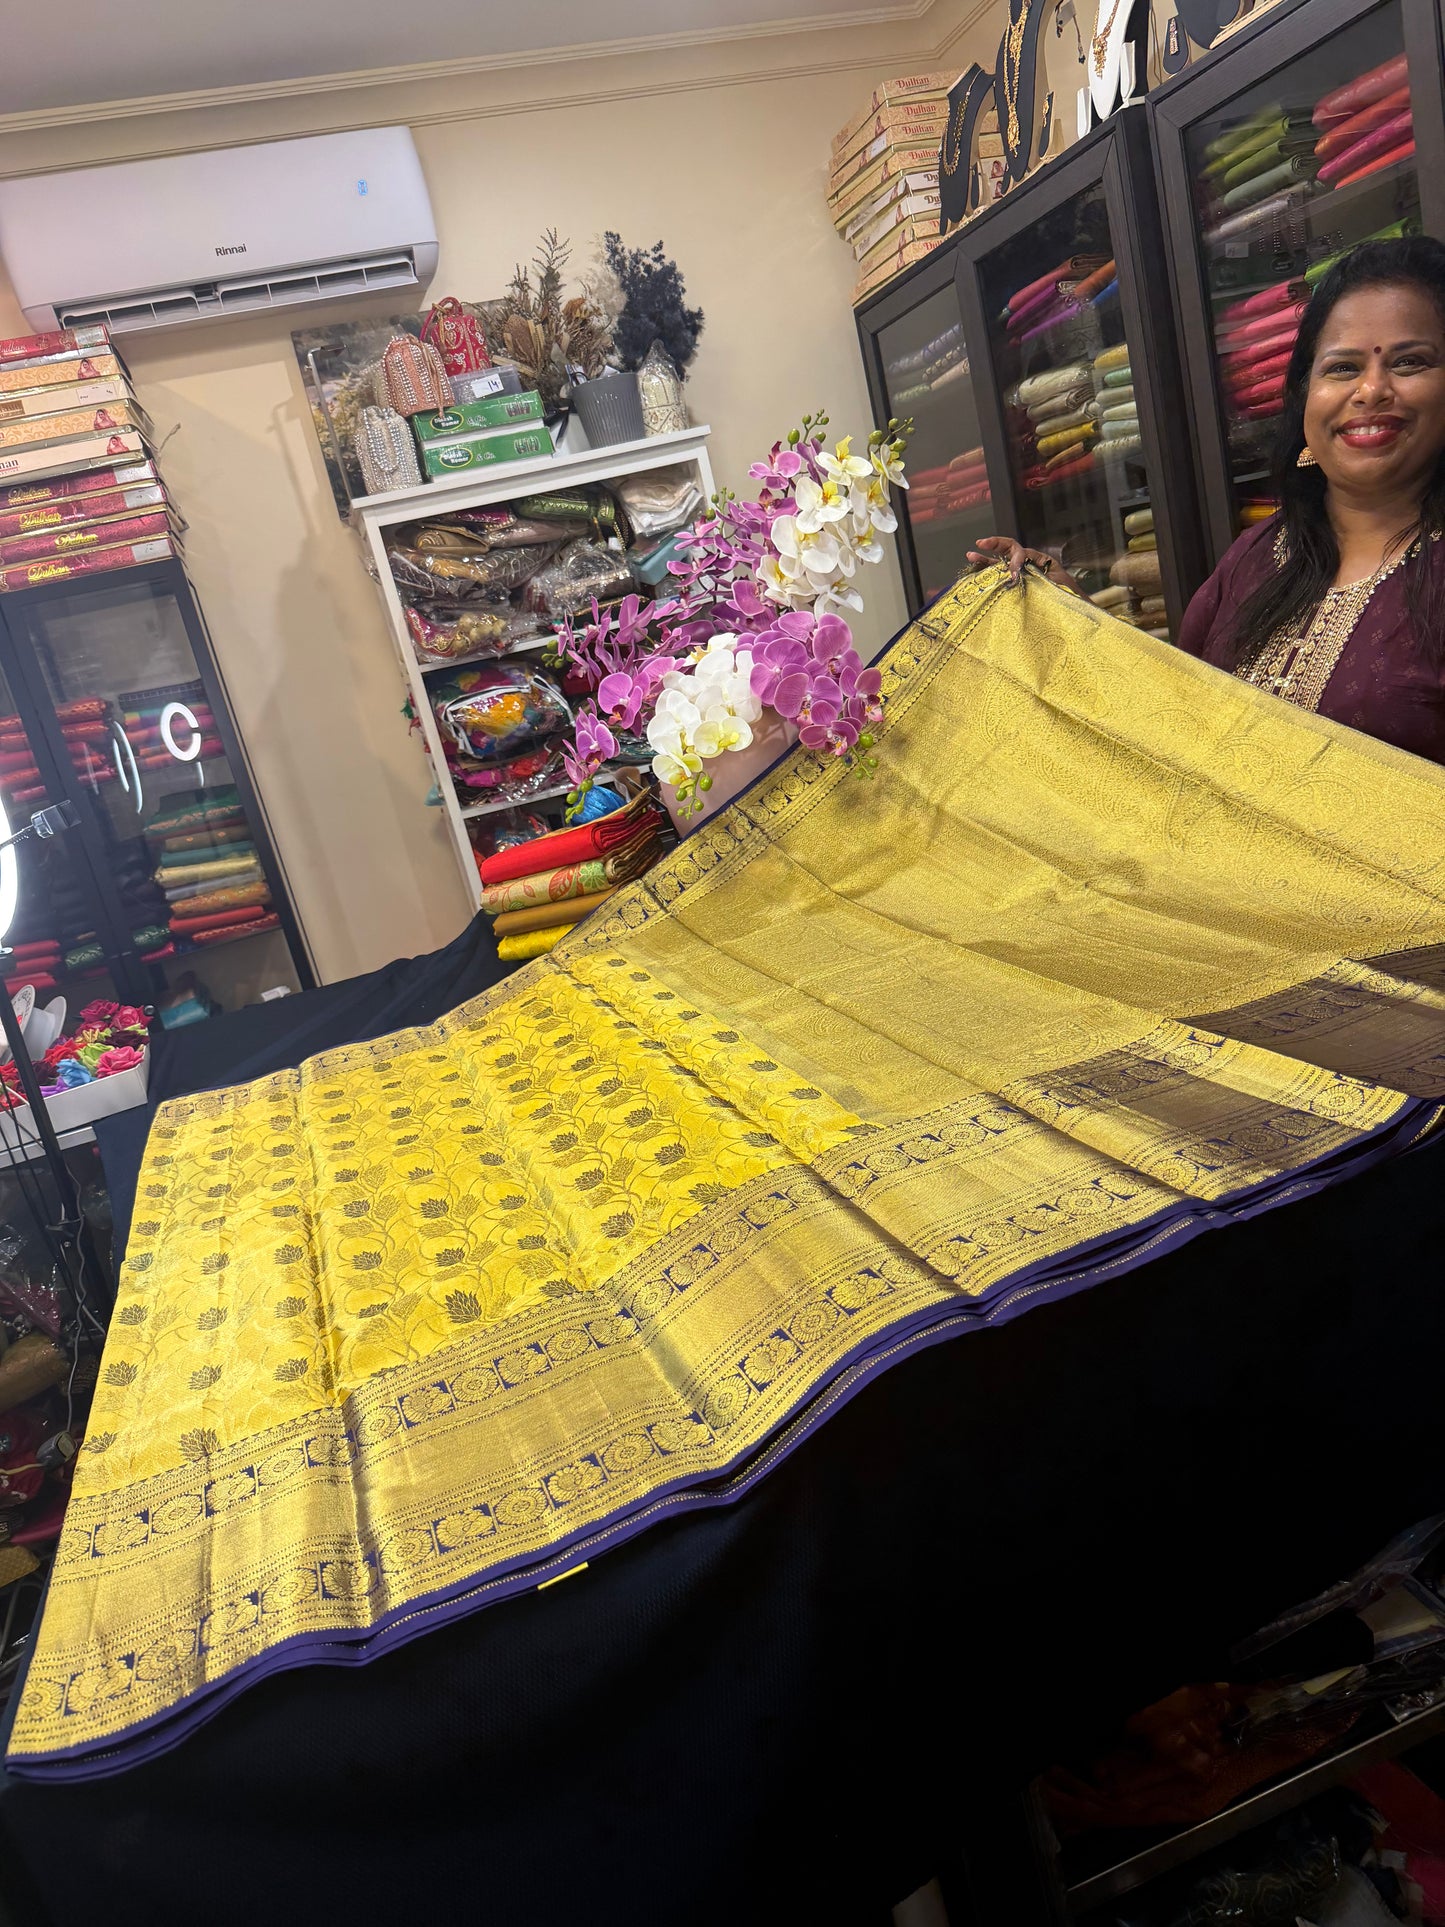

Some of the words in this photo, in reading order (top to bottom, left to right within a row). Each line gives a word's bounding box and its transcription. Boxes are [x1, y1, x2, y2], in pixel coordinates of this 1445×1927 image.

[895, 77, 930, 89] Dulhan
[904, 105, 937, 116] Dulhan
[902, 125, 935, 135] Dulhan
[215, 243, 247, 256] Rinnai
[487, 380, 500, 391] 14
